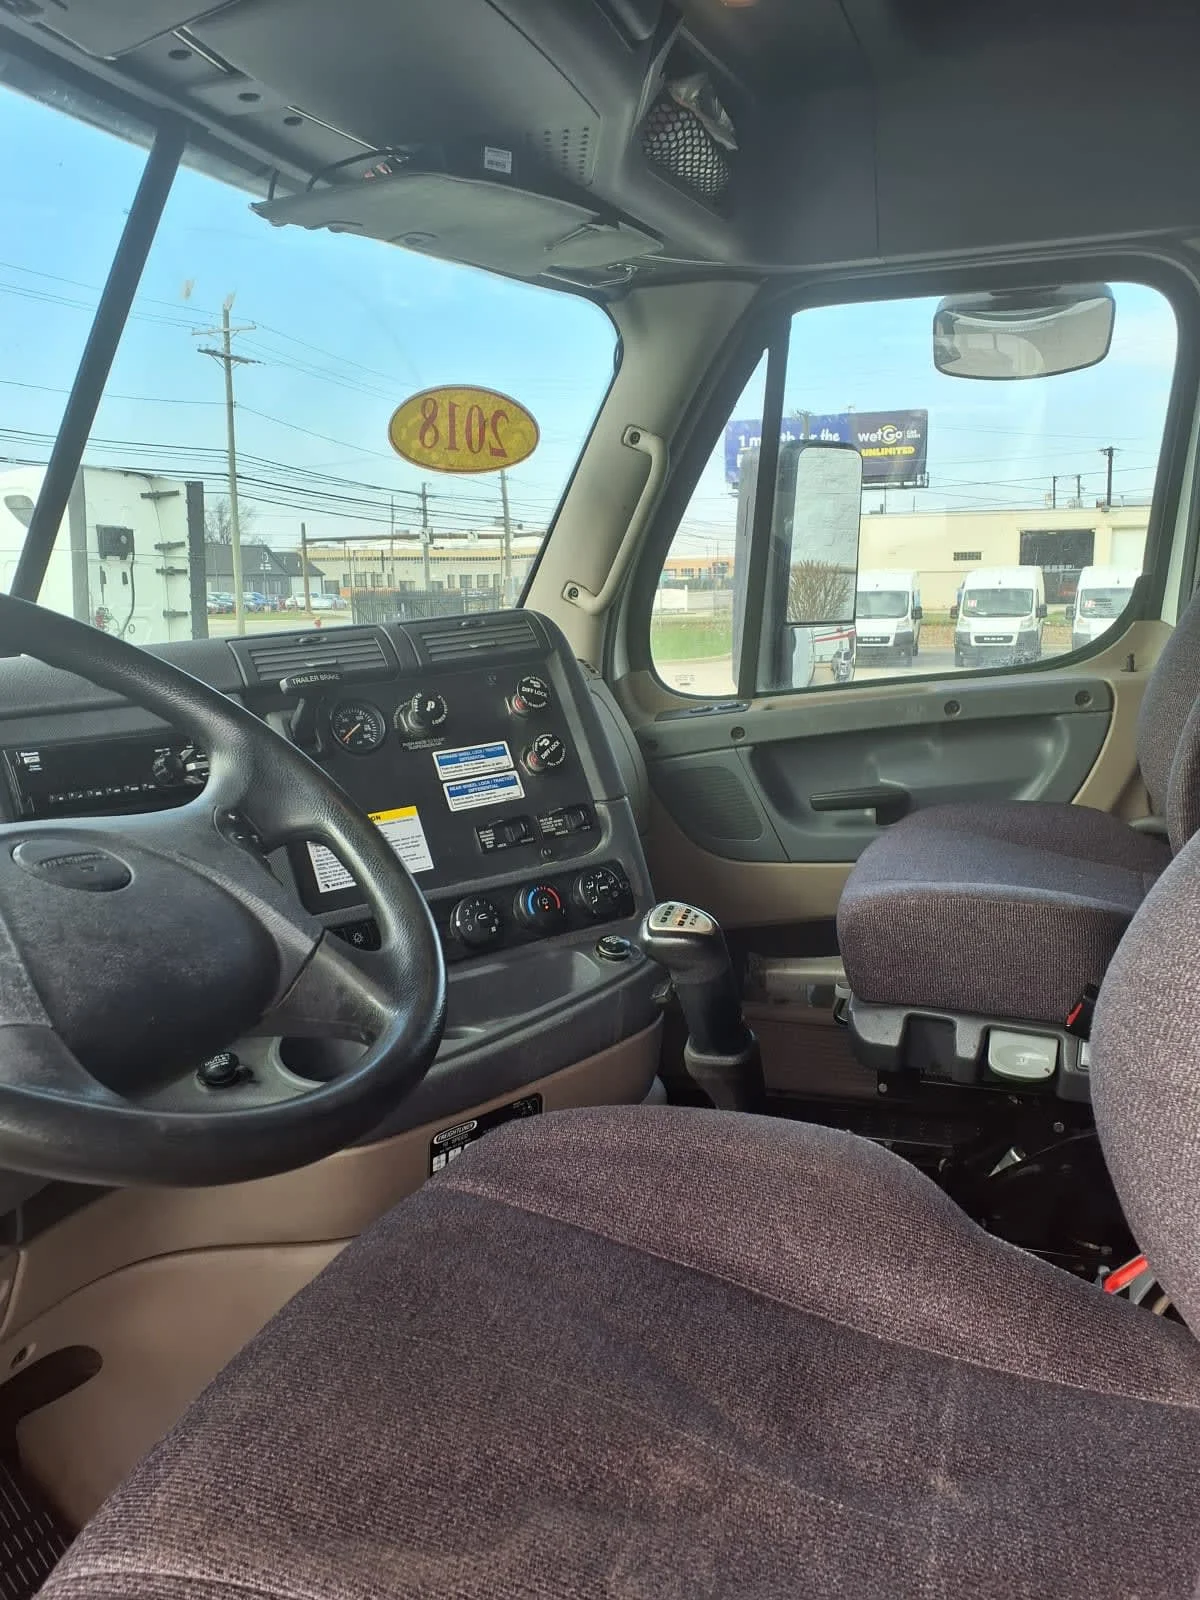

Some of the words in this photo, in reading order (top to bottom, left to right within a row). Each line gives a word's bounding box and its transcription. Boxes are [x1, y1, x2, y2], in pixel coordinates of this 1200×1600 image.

[857, 427, 903, 442] wetGo
[861, 446, 915, 457] UNLIMITED
[292, 675, 319, 685] TRAILER
[320, 673, 341, 681] BRAKE
[521, 685, 534, 695] DIFF
[534, 688, 548, 698] LOCK
[540, 748, 551, 760] DIFF
[549, 740, 561, 752] LOCK
